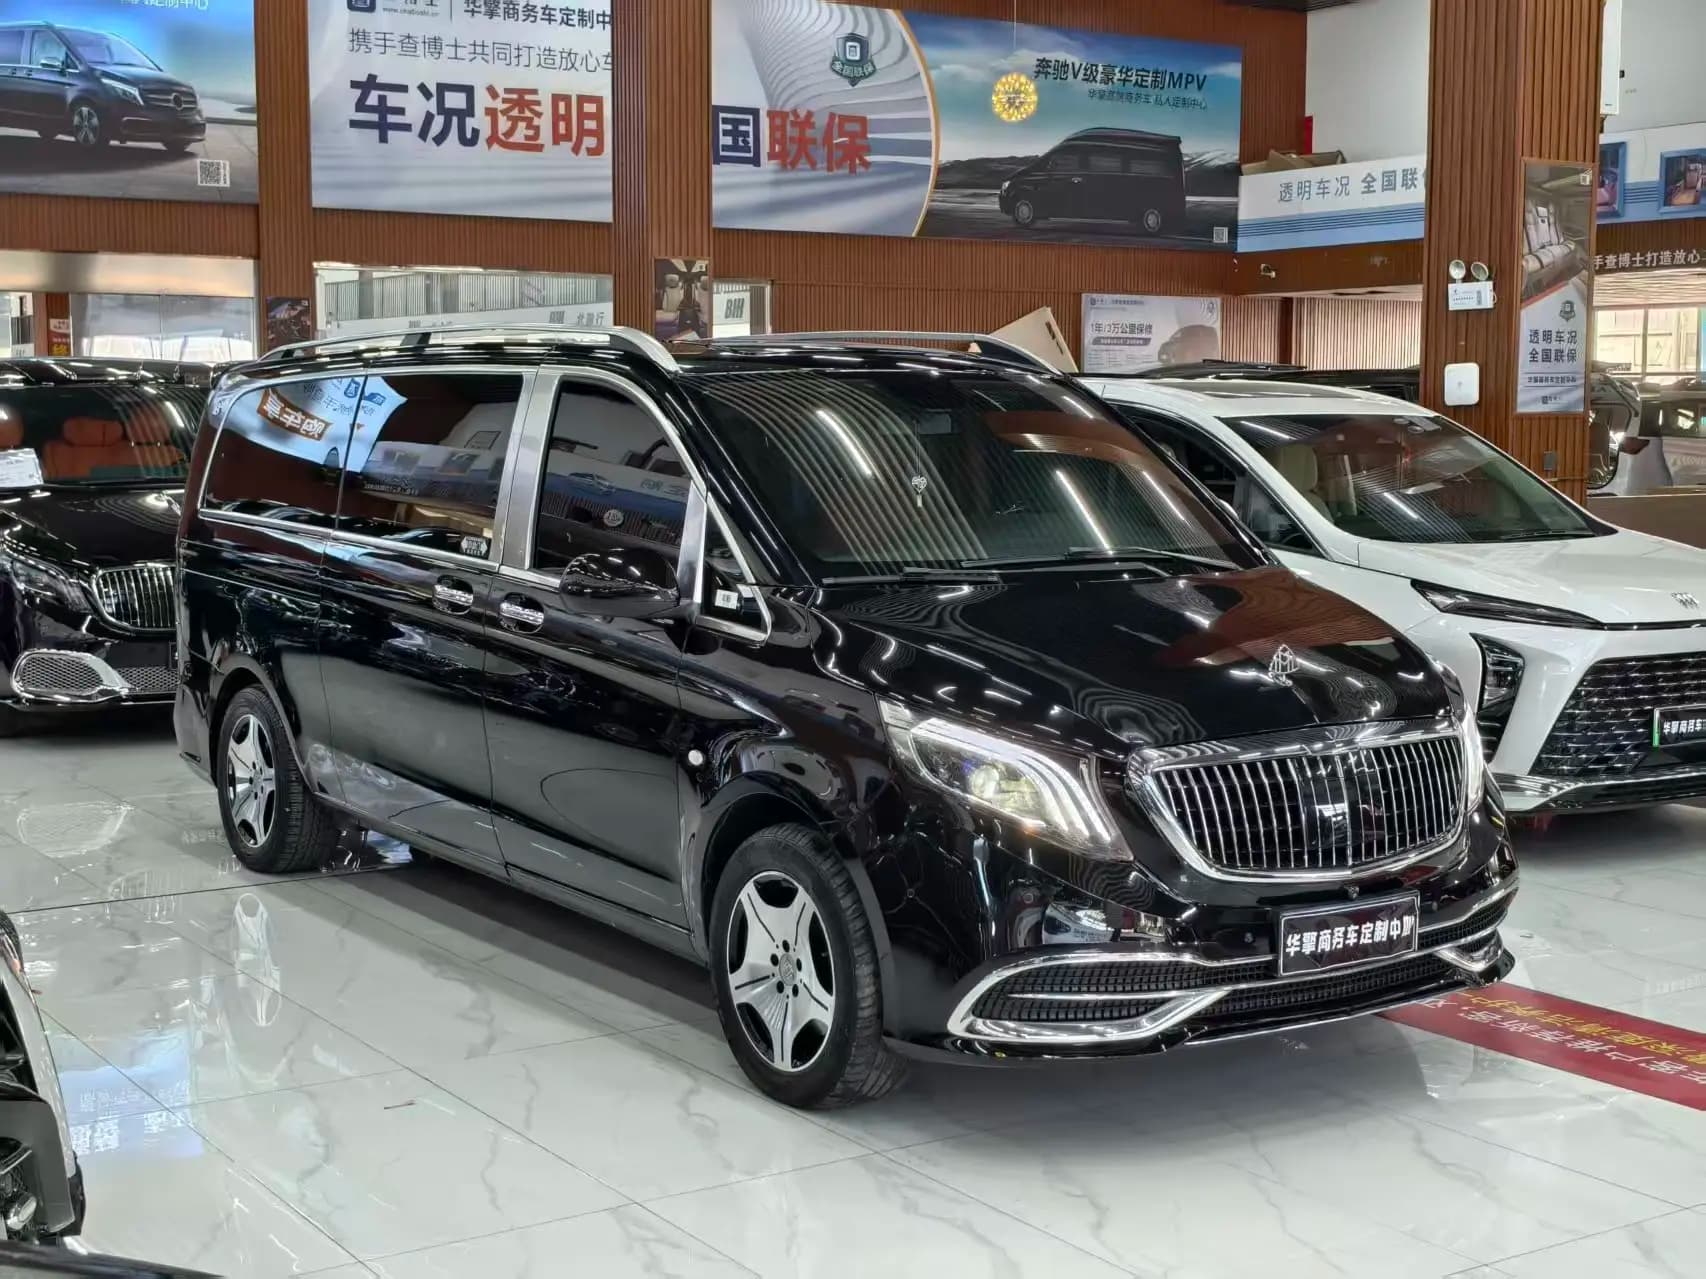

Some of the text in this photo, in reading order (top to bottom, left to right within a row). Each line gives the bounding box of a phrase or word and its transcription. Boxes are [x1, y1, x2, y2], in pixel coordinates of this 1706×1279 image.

[1033, 57, 1208, 91] 奔驰V级豪华定制MPV
[349, 73, 606, 157] 车况透明
[712, 104, 872, 174] 国联保
[1278, 165, 1426, 202] 透明车况 全国联
[1594, 249, 1706, 270] 手查博士打造放心
[1528, 328, 1578, 345] 透明车况
[1528, 347, 1577, 363] 全国联保
